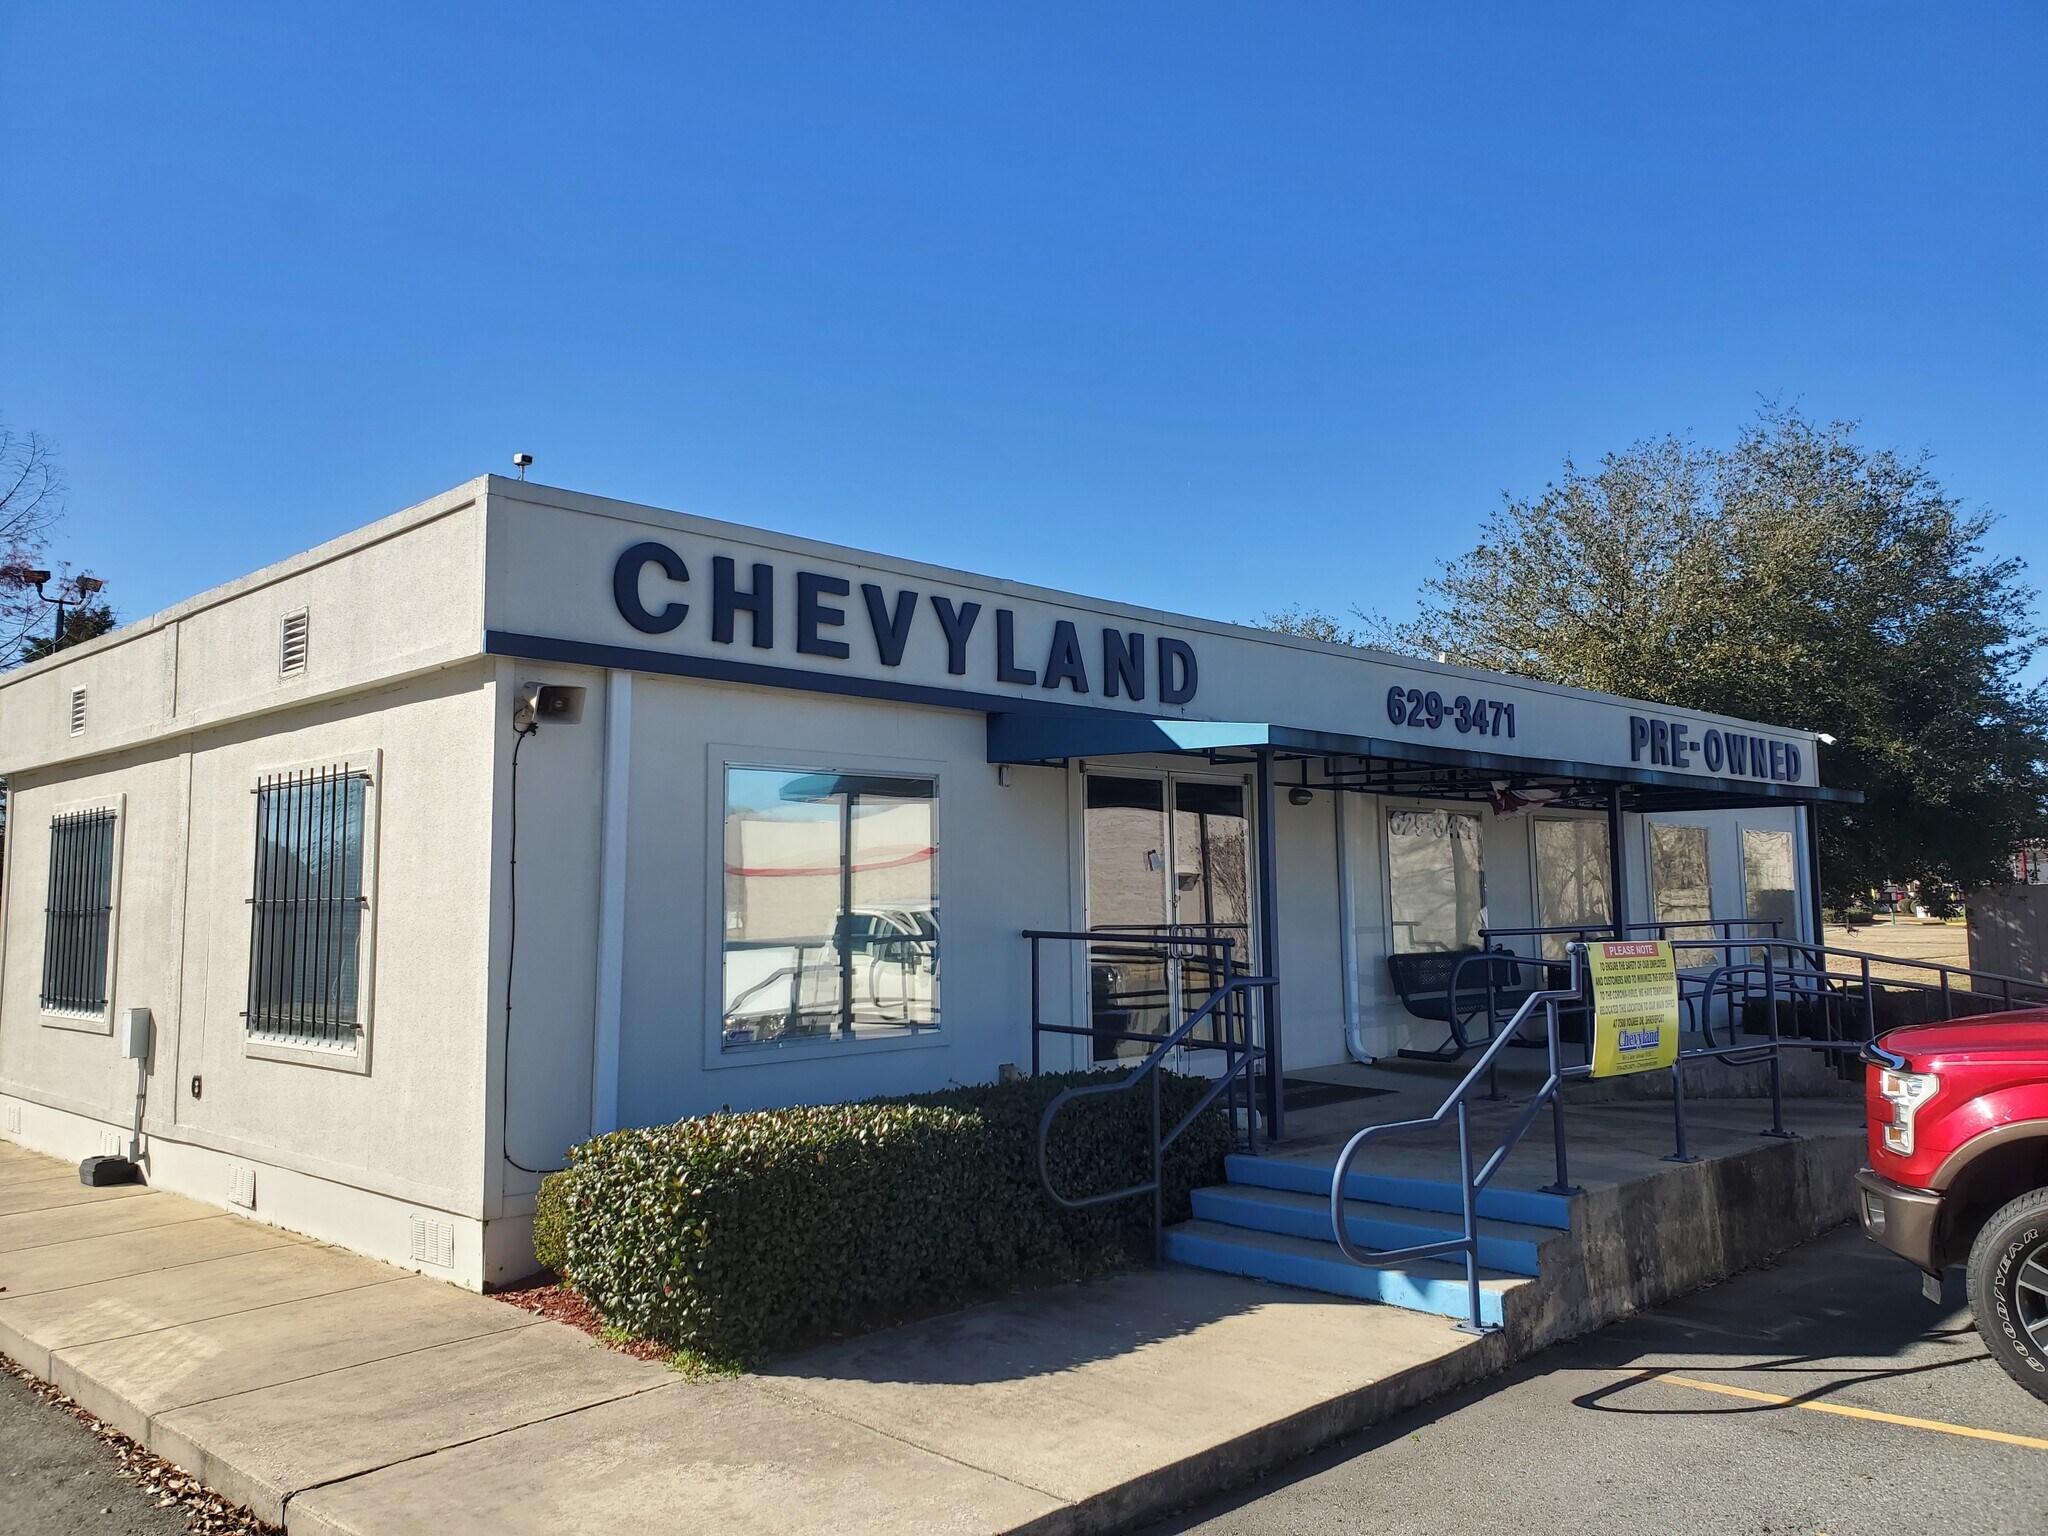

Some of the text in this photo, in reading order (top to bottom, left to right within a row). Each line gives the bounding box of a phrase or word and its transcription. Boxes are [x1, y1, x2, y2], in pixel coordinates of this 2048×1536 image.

[613, 542, 1199, 704] CHEVYLAND
[1387, 685, 1516, 738] 629-3471
[1630, 716, 1802, 782] PRE-OWNED
[1609, 944, 1654, 956] PLEASE NOTE
[1600, 962, 1605, 971] TO
[1605, 961, 1618, 971] ENSURE
[1625, 960, 1637, 970] SAFETY
[1637, 960, 1642, 969] OF
[1650, 959, 1666, 968] EMPLOYEES
[1604, 976, 1623, 985] CUSTOMERS
[1631, 975, 1636, 984] TO
[1600, 991, 1605, 1000] TO
[1643, 1002, 1648, 1010] TO
[1618, 1027, 1659, 1048] Chevyland
[1994, 1229, 2046, 1372] GOODYEAR
